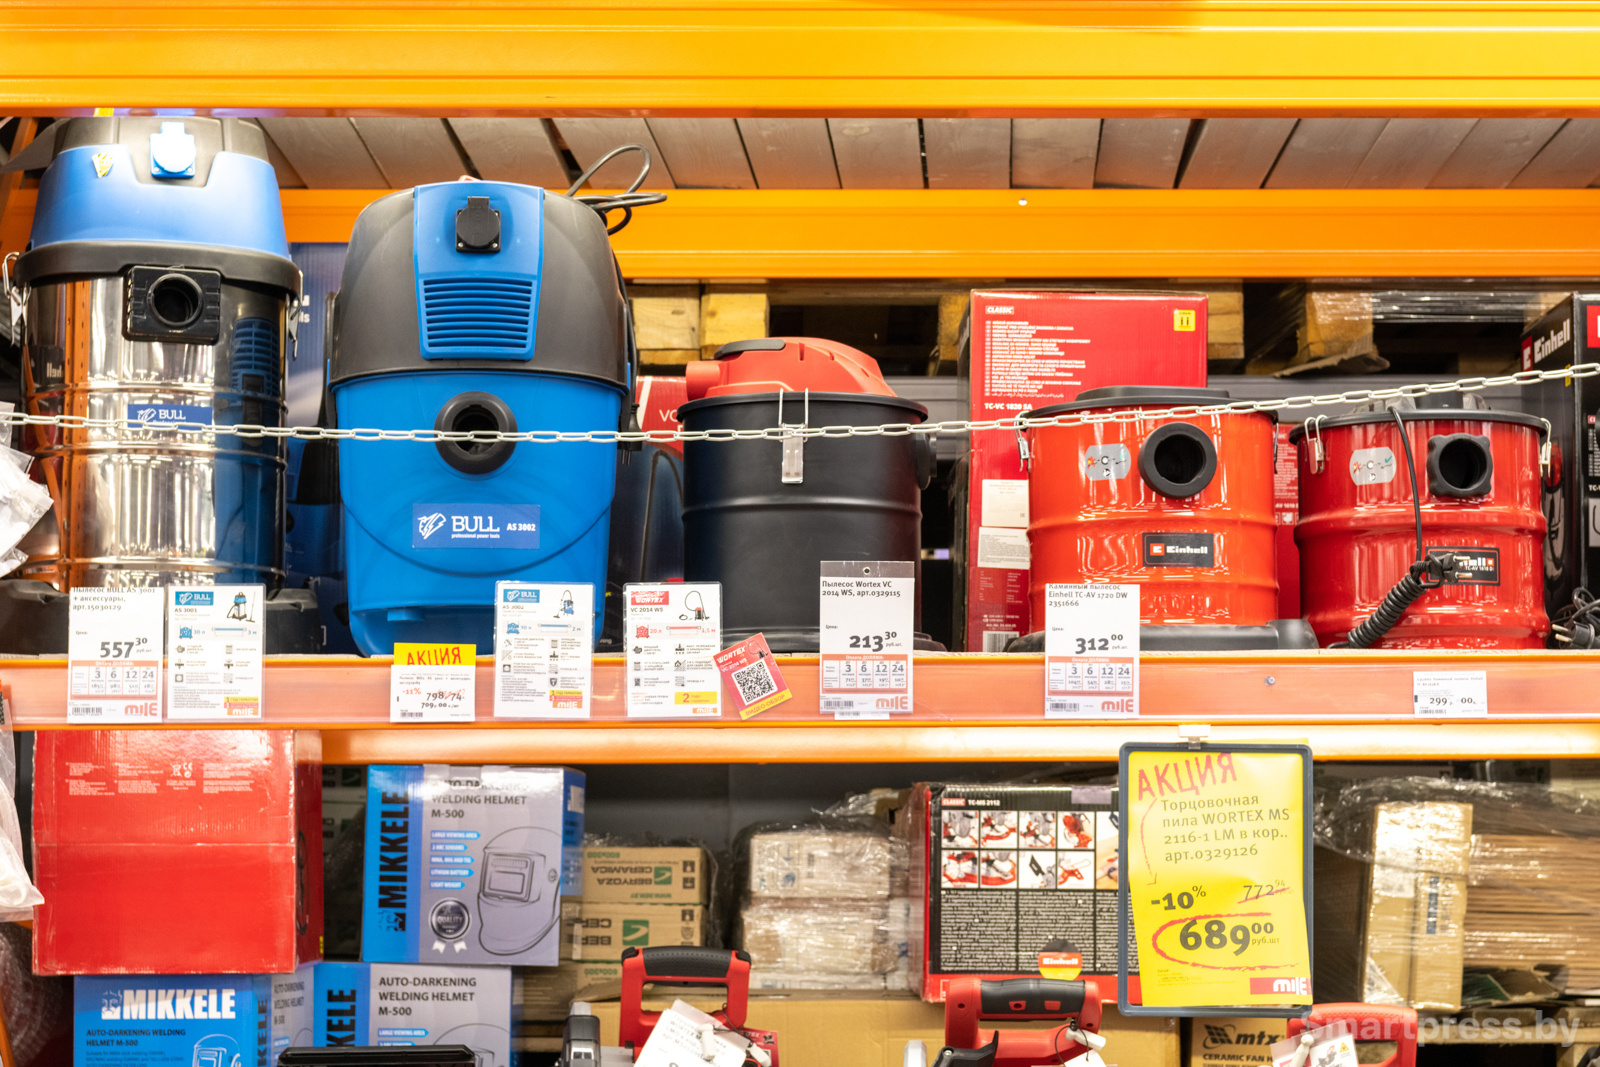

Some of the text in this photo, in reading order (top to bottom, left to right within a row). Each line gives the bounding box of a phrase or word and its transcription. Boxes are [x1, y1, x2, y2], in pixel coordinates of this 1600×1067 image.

[1534, 318, 1570, 364] Einhell
[159, 409, 186, 420] BULL
[451, 515, 536, 532] BULL AS 3002
[1166, 545, 1208, 555] Einhell
[822, 580, 892, 588] Пылесос Wortex VC
[841, 589, 855, 597] WS,
[849, 635, 883, 652] 213
[885, 631, 897, 640] 30
[1075, 637, 1109, 654] 312
[100, 637, 148, 658] 557 30
[407, 646, 462, 665] АКЦИЯ
[716, 646, 746, 663] WORTEX
[845, 664, 904, 672] 3 6 12 24
[1071, 667, 1130, 675] 3 6 12 24
[94, 670, 154, 679] 3 6 12 24
[682, 693, 690, 703] 2
[1430, 697, 1447, 706] 299
[1138, 753, 1237, 801] АКЦИЯ
[432, 795, 527, 805] WELDING HELMET
[1161, 795, 1259, 813] Торцовочная
[431, 809, 464, 818] M-500
[1163, 808, 1290, 828] пила WORTEX MS
[1164, 830, 1210, 845] 2116-1
[1214, 828, 1235, 841] LM
[1240, 831, 1247, 839] в
[378, 792, 409, 909] MIKKELE
[1165, 844, 1258, 864] арт.0329126
[591, 866, 652, 874] CERAMICA
[1179, 919, 1251, 957] 689
[1251, 922, 1274, 934] 00
[1043, 957, 1079, 965] Einhell
[379, 977, 477, 987] AUTO-DARKENING
[378, 992, 475, 1001] WELDING HELMET
[123, 988, 236, 1020] MIKKELE
[378, 1006, 412, 1016] M-500
[1235, 1031, 1279, 1045] mtx
[1203, 1053, 1265, 1062] CERAMIC FAN
